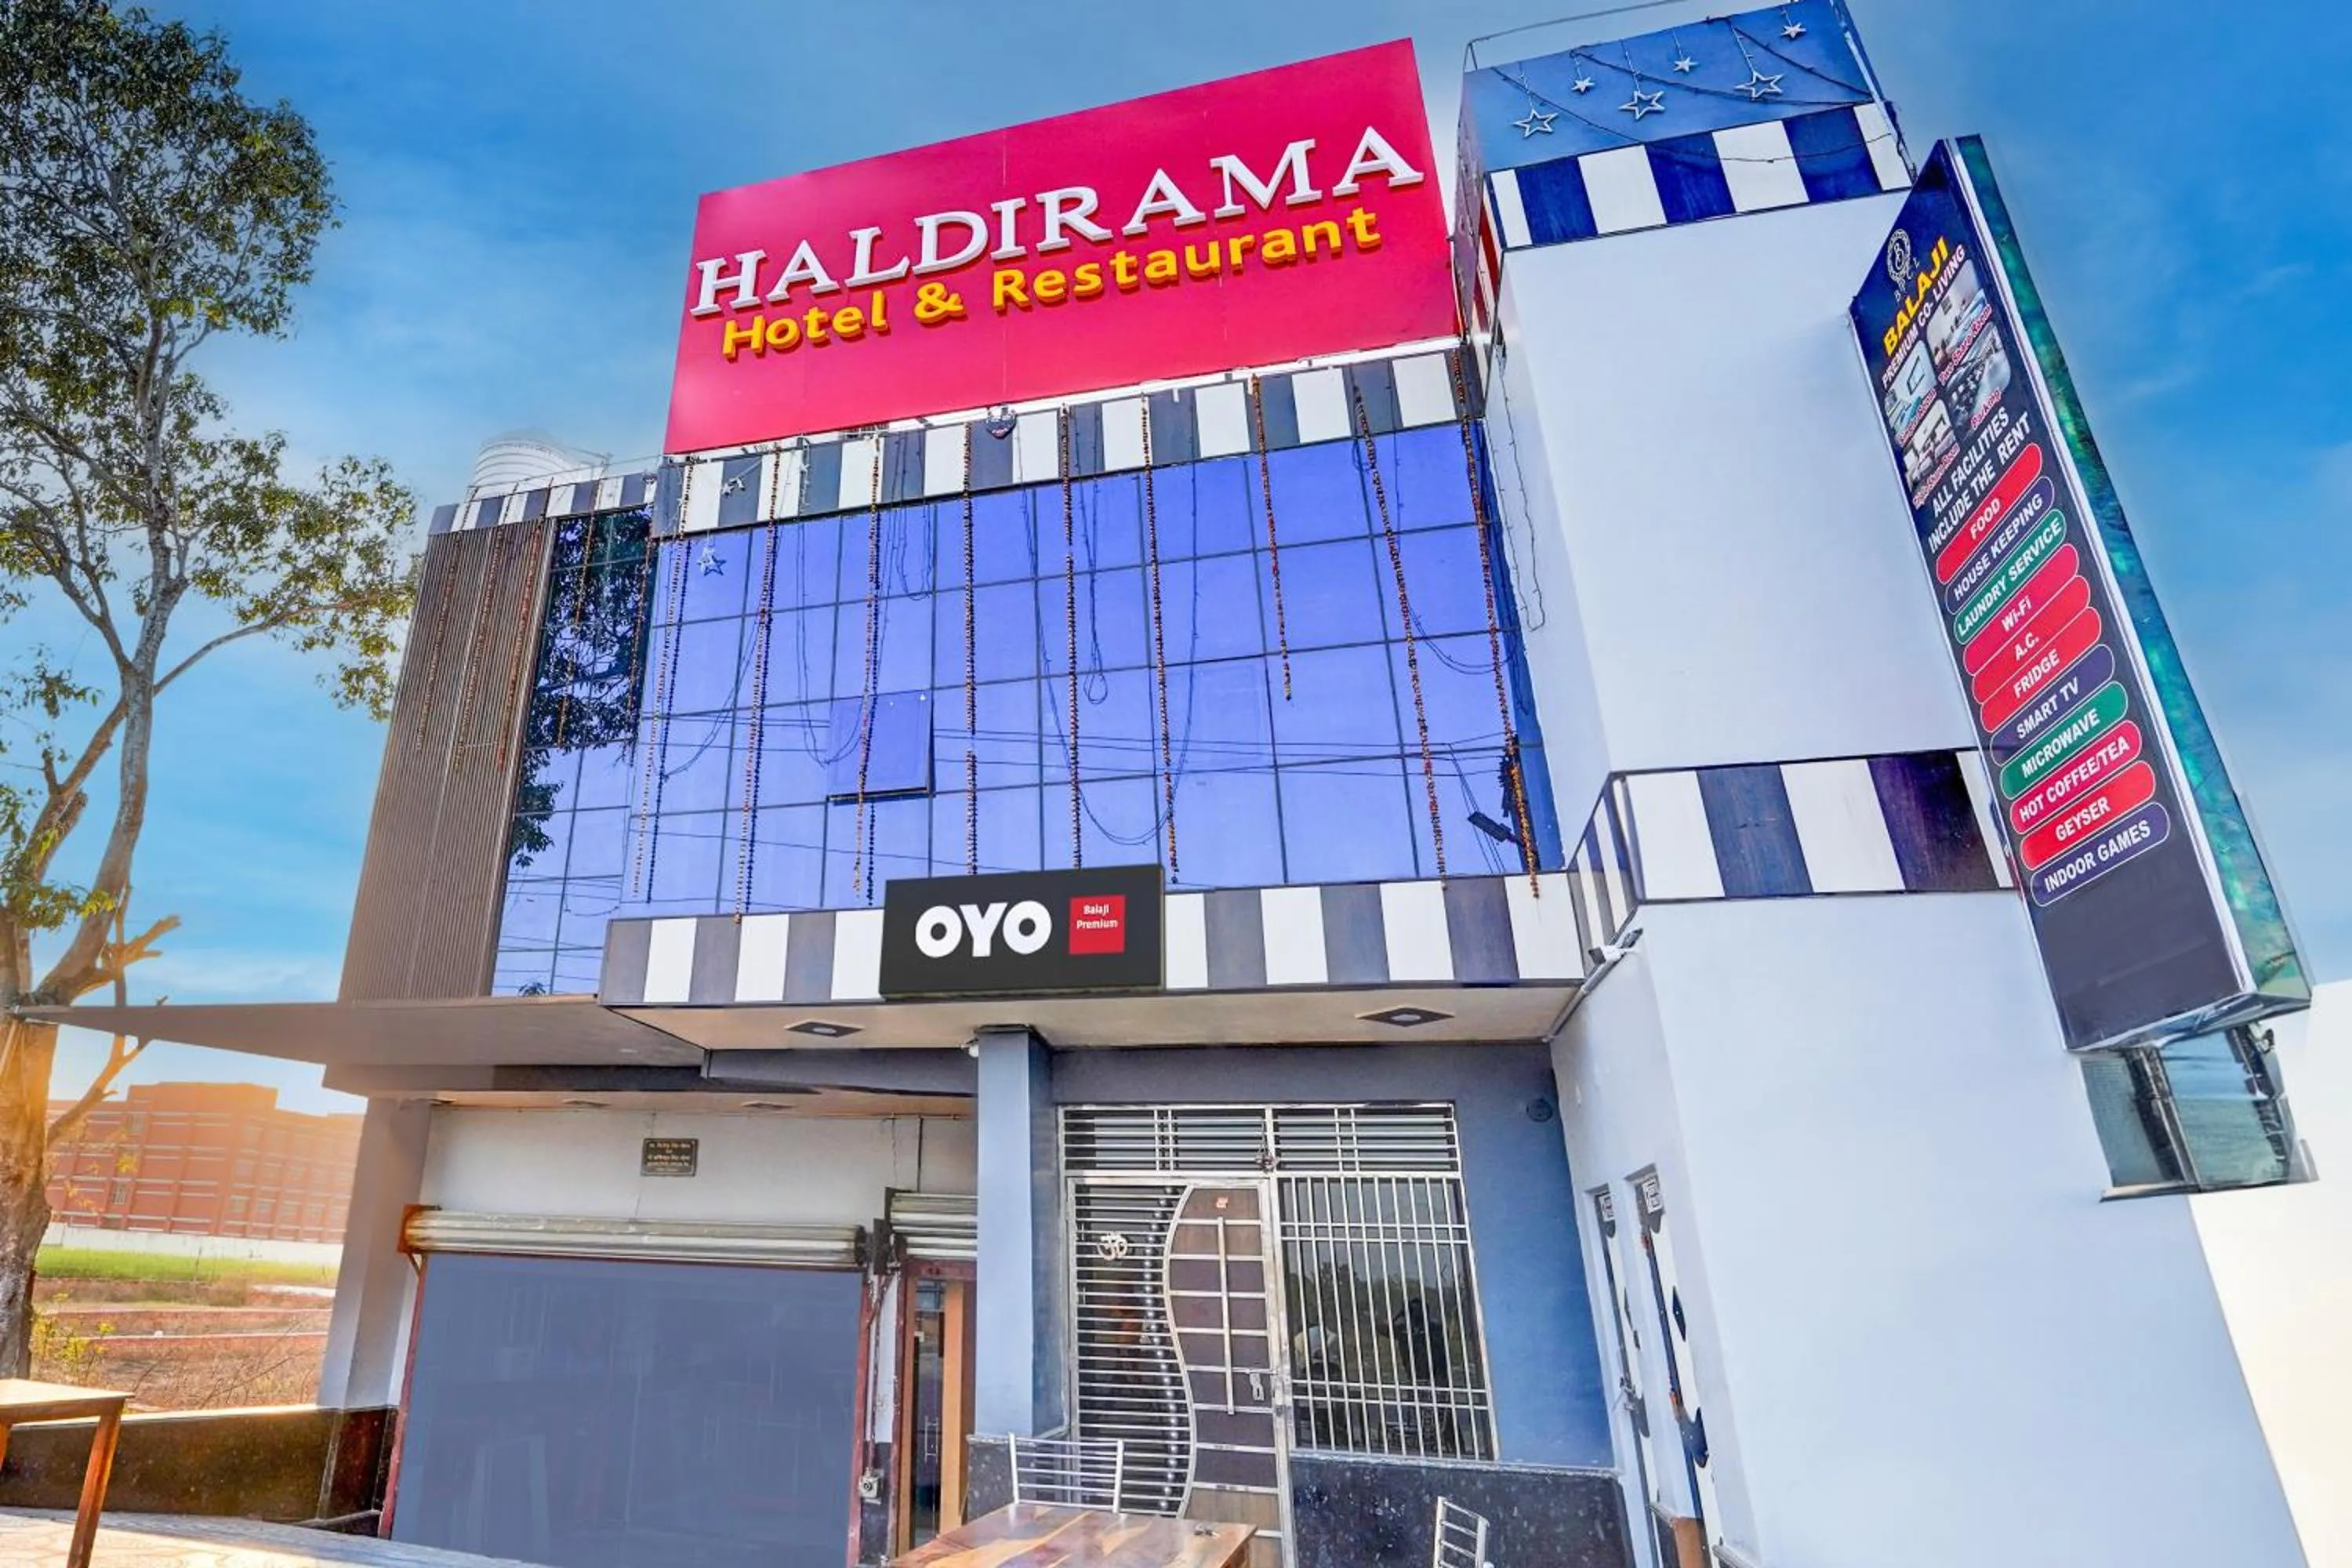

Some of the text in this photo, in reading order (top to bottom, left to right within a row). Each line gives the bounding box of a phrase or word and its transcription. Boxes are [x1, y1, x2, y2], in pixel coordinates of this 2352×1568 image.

[691, 126, 1424, 315] HALDIRAMA
[722, 204, 1381, 360] Hotel & Restaurant
[1882, 324, 1918, 387] PREMIUM
[1933, 245, 1965, 301] LIVING
[1883, 236, 1947, 357] BALAJI
[1928, 412, 2031, 554] INCLUDE THE RENT
[1932, 406, 2009, 517] ALL FACILITIES
[1954, 493, 2042, 601] HOUSE KEEPING
[1969, 498, 2001, 540] FOOD
[1958, 517, 2061, 637] LAUNDRY SERVICE
[2001, 595, 2031, 632] Wi-Fi
[2014, 632, 2040, 661] A.C.
[2013, 648, 2060, 699] FRIDGE
[2016, 676, 2078, 739] SMART TV
[2021, 708, 2100, 778] MICROWAVE
[2019, 736, 2130, 822] HOT COFFEE/TEA
[2055, 797, 2111, 841] GEYSER
[2045, 820, 2151, 893] INDOOR GAMES
[915, 900, 1052, 958] OYO
[1076, 918, 1118, 930] Premium
[1083, 903, 1109, 916] Balaji
